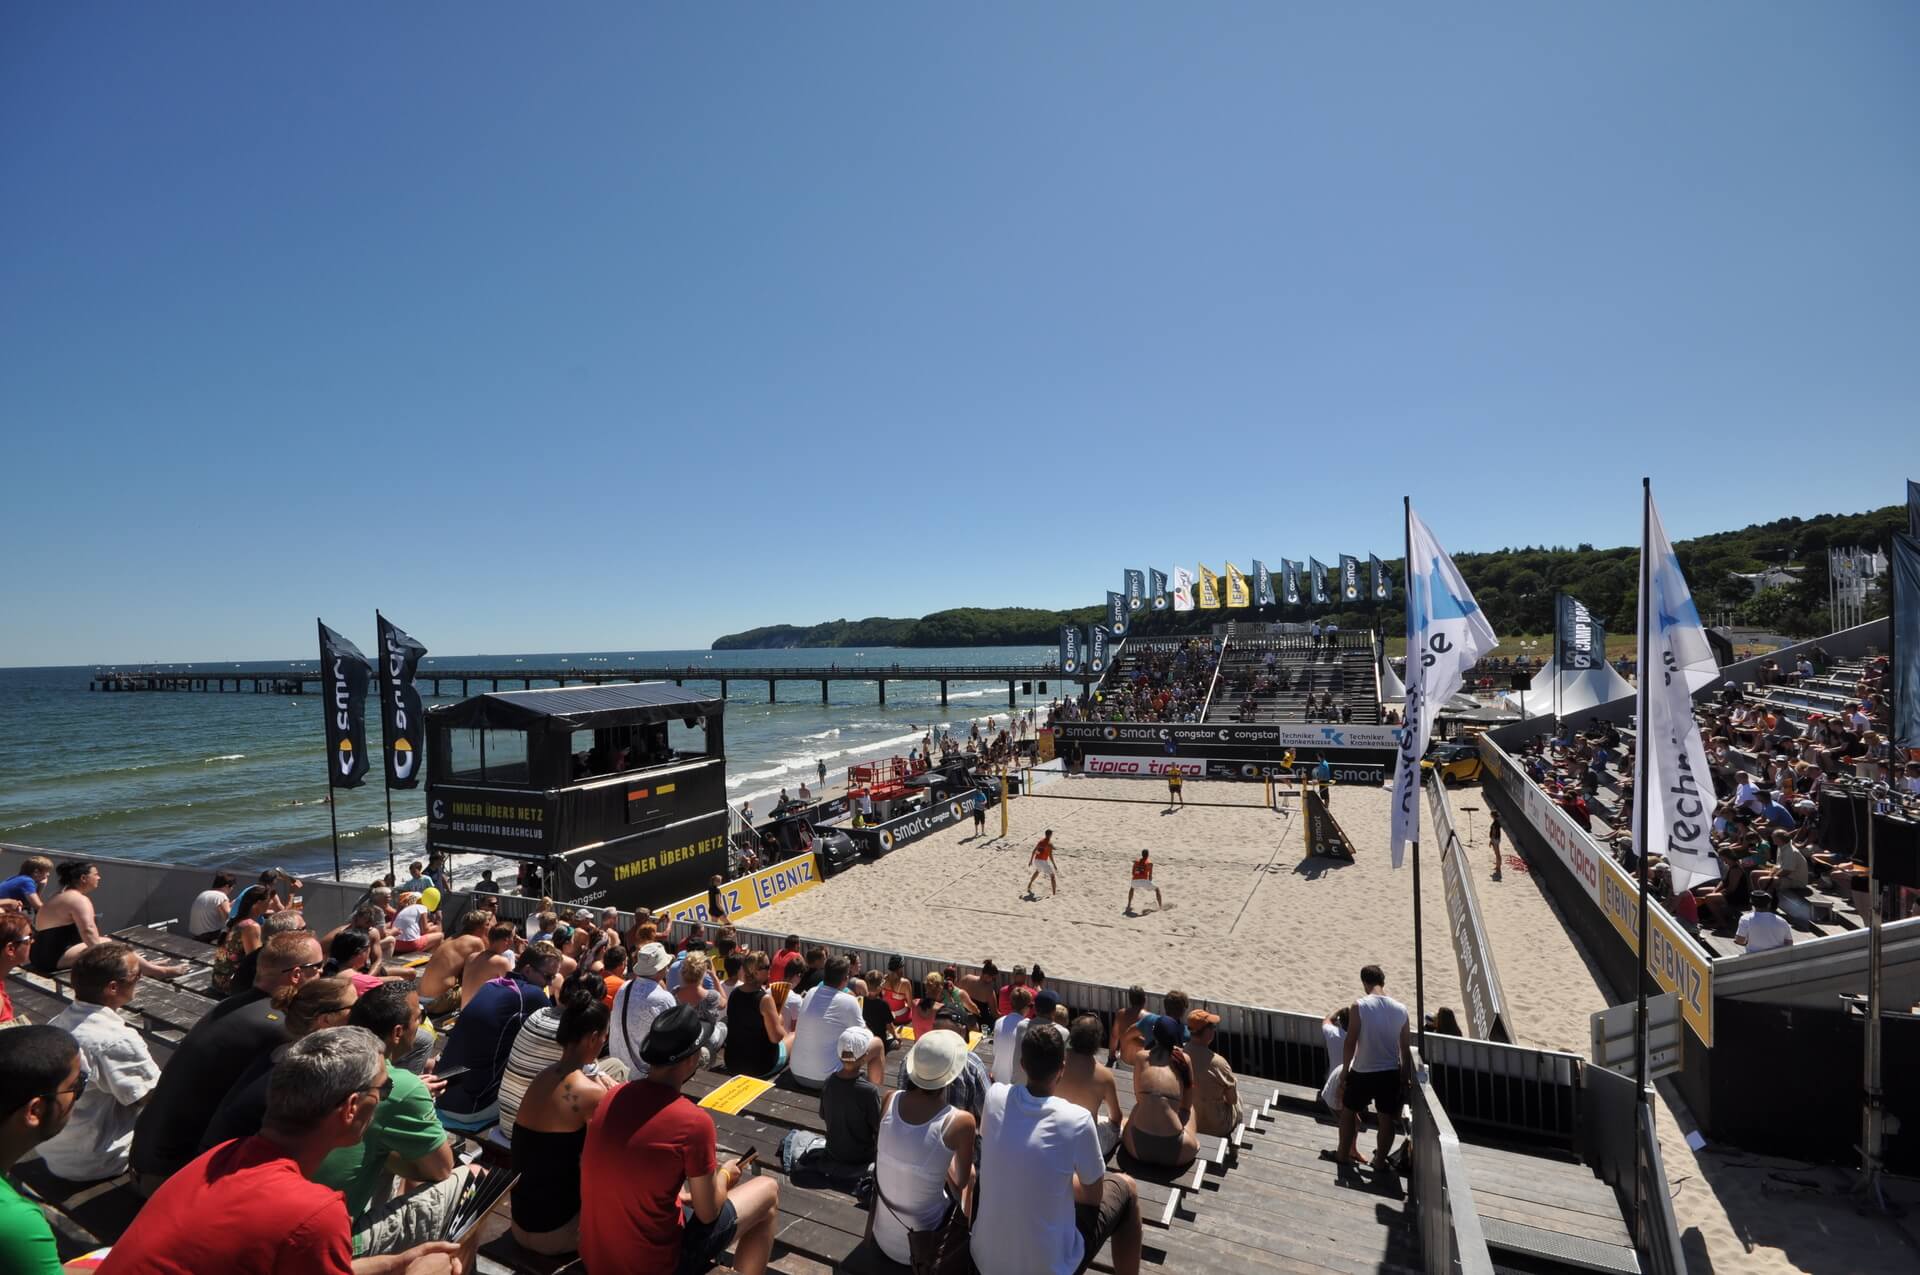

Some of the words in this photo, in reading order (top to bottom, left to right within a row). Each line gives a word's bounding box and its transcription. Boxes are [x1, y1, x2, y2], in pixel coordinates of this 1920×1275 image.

[1065, 628, 1075, 658] smart
[1575, 624, 1592, 651] CAMP
[1066, 727, 1101, 737] smart
[1120, 727, 1156, 740] smart
[1174, 730, 1216, 740] congstar
[1234, 730, 1279, 741] congstar
[1089, 757, 1139, 772] tipico
[1148, 759, 1202, 776] tipco
[1333, 769, 1383, 782] smart
[452, 802, 483, 816] IMMER
[485, 802, 515, 819] ÜBERS
[518, 807, 544, 821] NETZ
[452, 822, 465, 831] DER
[466, 823, 500, 835] CONGSTAR
[501, 826, 543, 839] BEACHCLUB
[893, 817, 925, 841] smart
[614, 856, 657, 881] IMMER
[660, 845, 696, 867] ÜBERS
[698, 835, 724, 855] NETZ
[1544, 808, 1566, 851] tipico
[1568, 832, 1597, 889] tipico
[752, 861, 813, 909] LEIBNIZ
[1648, 909, 1702, 1016] LEIBNIZ
